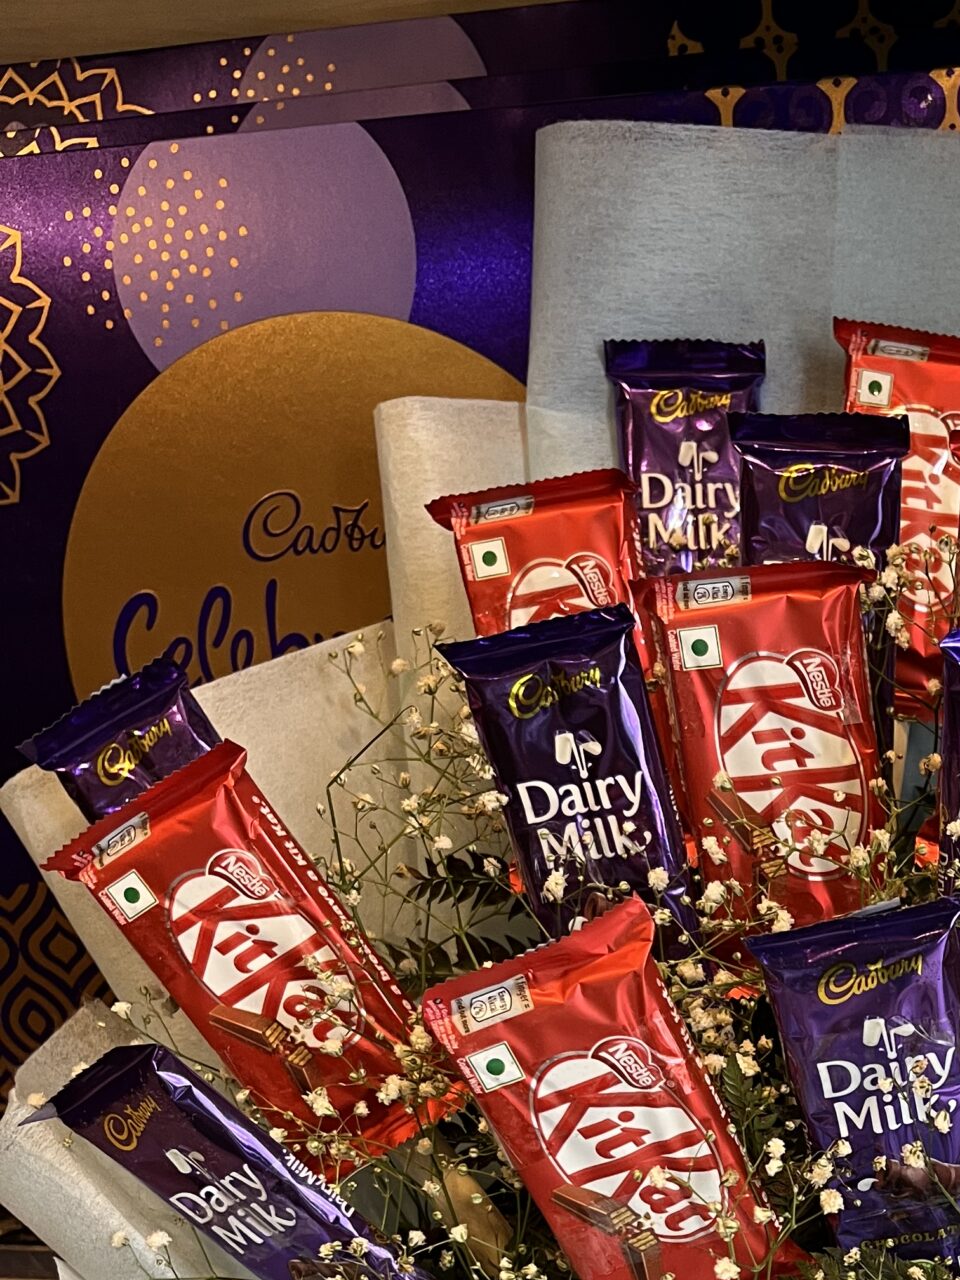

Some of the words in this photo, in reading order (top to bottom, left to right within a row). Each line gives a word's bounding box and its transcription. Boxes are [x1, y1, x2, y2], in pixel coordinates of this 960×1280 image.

[650, 389, 732, 423] Cadbury
[640, 473, 740, 518] Dairy
[778, 463, 869, 503] Cadbury
[648, 512, 732, 551] Milk
[508, 667, 601, 719] Cadbury
[97, 718, 173, 787] Cadbury
[517, 771, 643, 825] Dairy
[282, 836, 308, 868] Kit
[536, 815, 652, 870] Milk
[495, 989, 510, 1011] Energy
[513, 980, 530, 1003] finger
[817, 953, 924, 1005] Cadbury
[816, 1046, 955, 1099] Dairy
[103, 1095, 159, 1152] Cadbury
[536, 1072, 722, 1232] KitKat
[169, 1162, 268, 1225] Dairy
[212, 1205, 298, 1255] Milk
